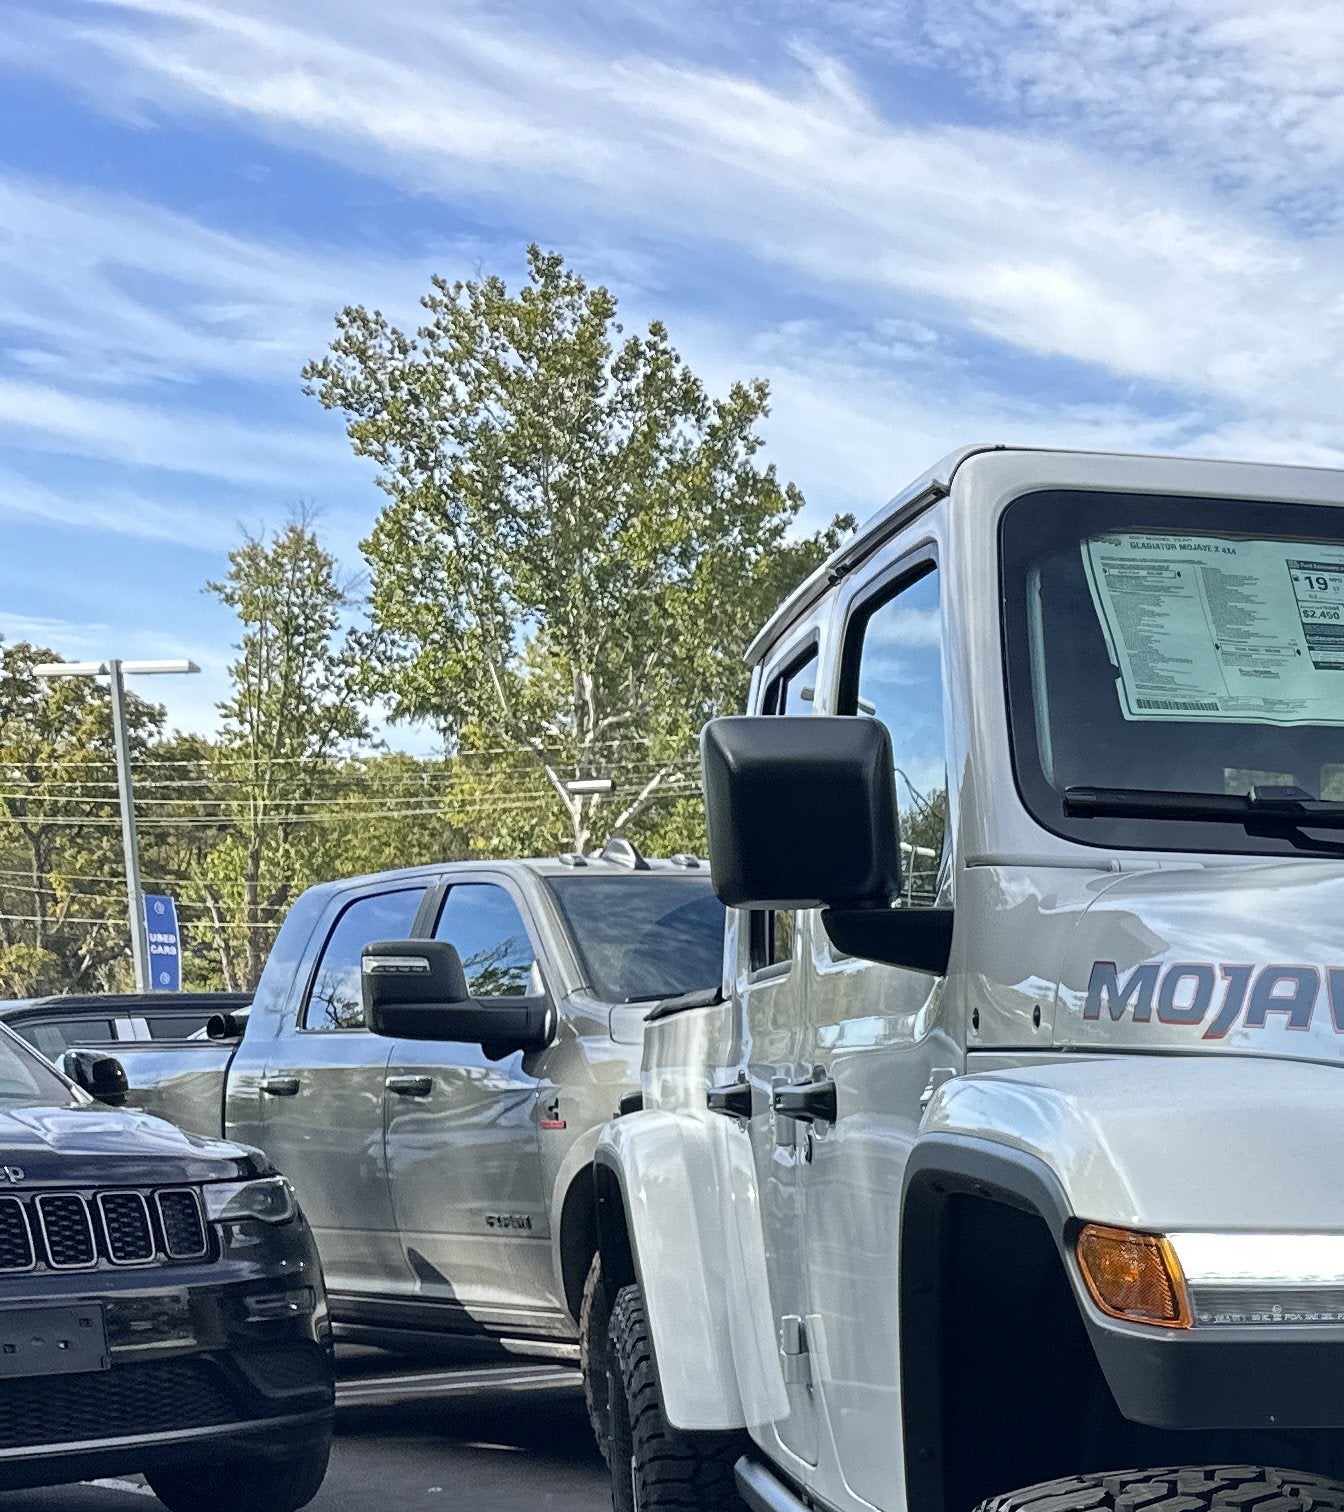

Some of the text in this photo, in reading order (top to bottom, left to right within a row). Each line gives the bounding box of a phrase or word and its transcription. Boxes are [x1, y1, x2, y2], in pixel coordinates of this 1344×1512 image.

[1129, 541, 1177, 551] GLADIATOR
[1178, 543, 1212, 552] MOJAVE
[1304, 576, 1329, 591] 19
[1302, 609, 1340, 619] $2,450
[149, 933, 176, 944] USED
[150, 945, 177, 955] CARS
